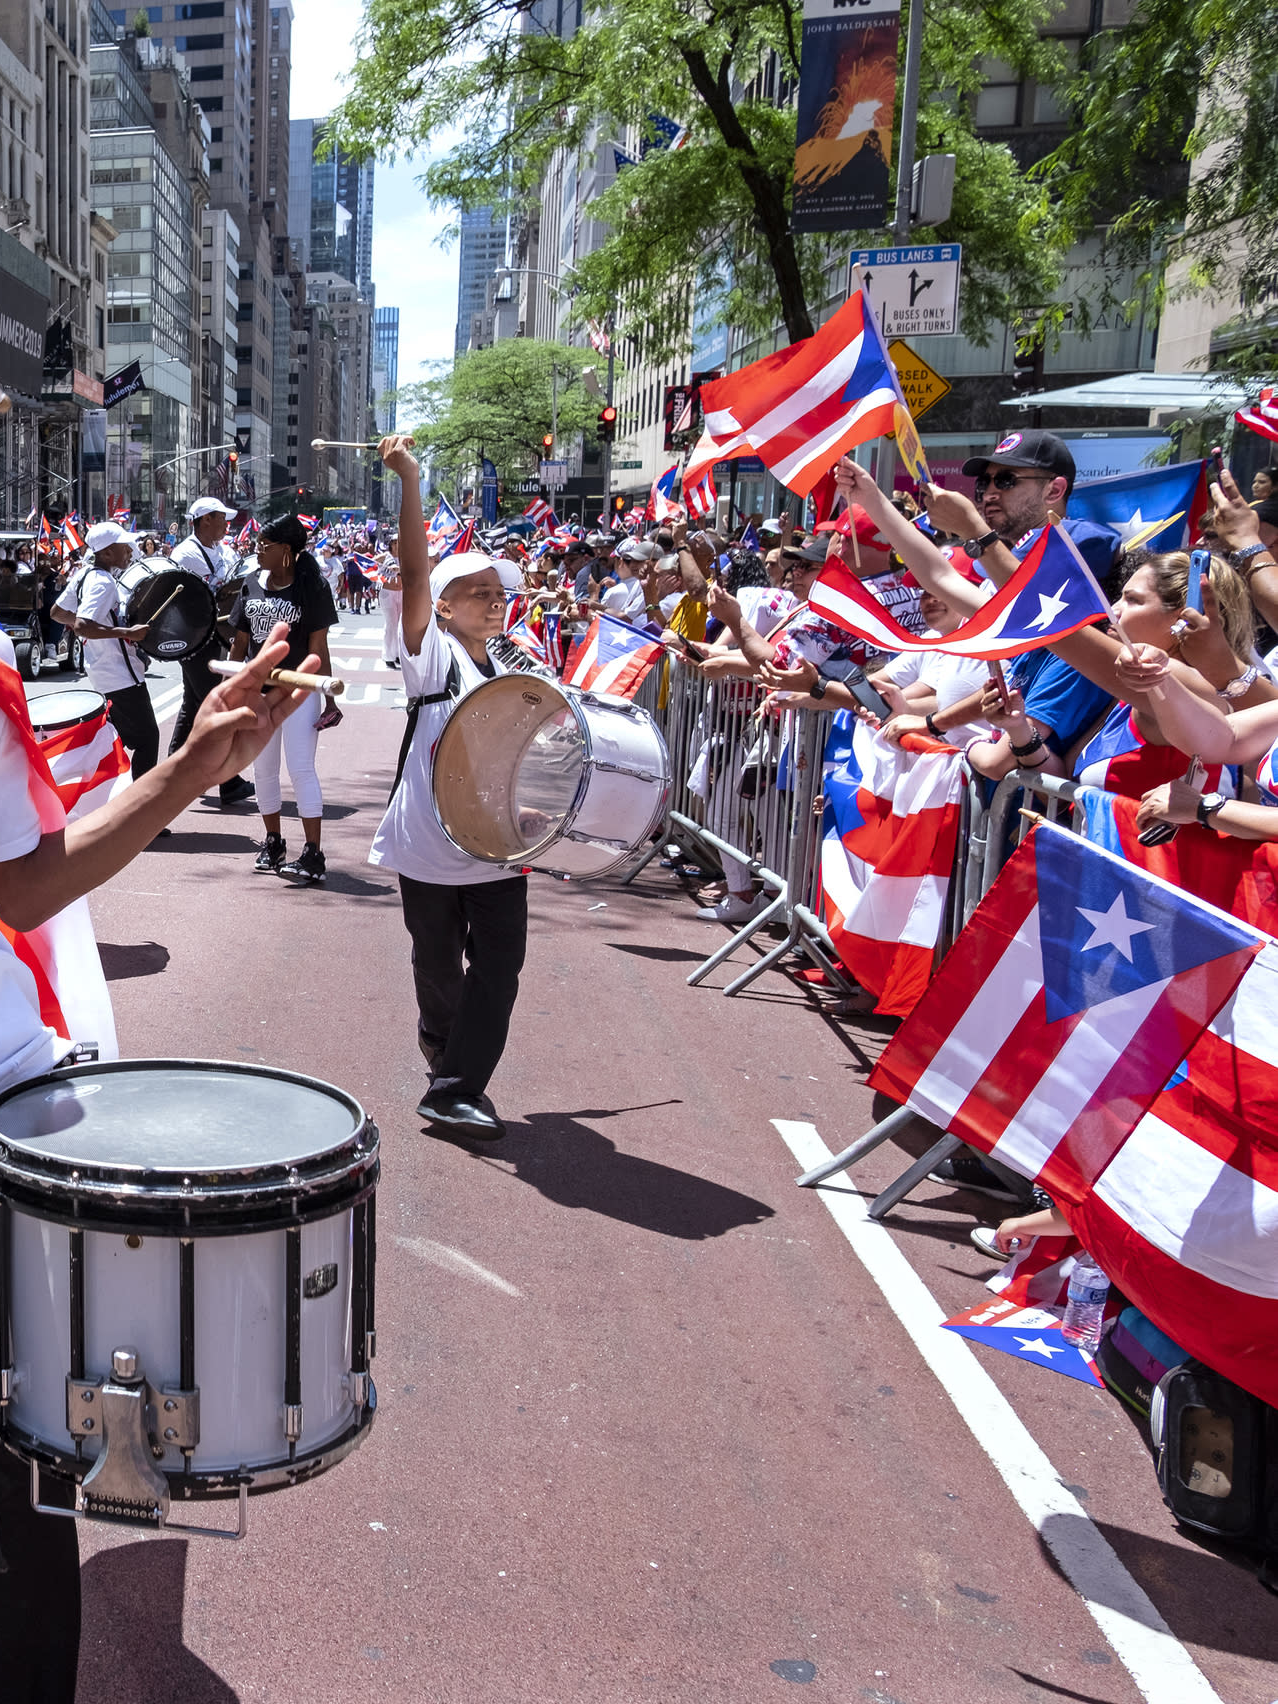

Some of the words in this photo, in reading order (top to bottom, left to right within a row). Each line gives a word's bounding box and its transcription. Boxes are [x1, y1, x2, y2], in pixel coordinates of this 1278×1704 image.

[807, 24, 832, 35] JOHN
[836, 19, 895, 31] BALDESSARI
[876, 252, 898, 264] BUS
[901, 250, 934, 262] LANES
[893, 309, 920, 320] BUSES
[923, 308, 945, 319] ONLY
[886, 323, 893, 333] &
[897, 322, 920, 332] RIGHT
[923, 320, 951, 331] TURNS
[25, 329, 43, 360] 2019
[162, 642, 183, 650] EVANS
